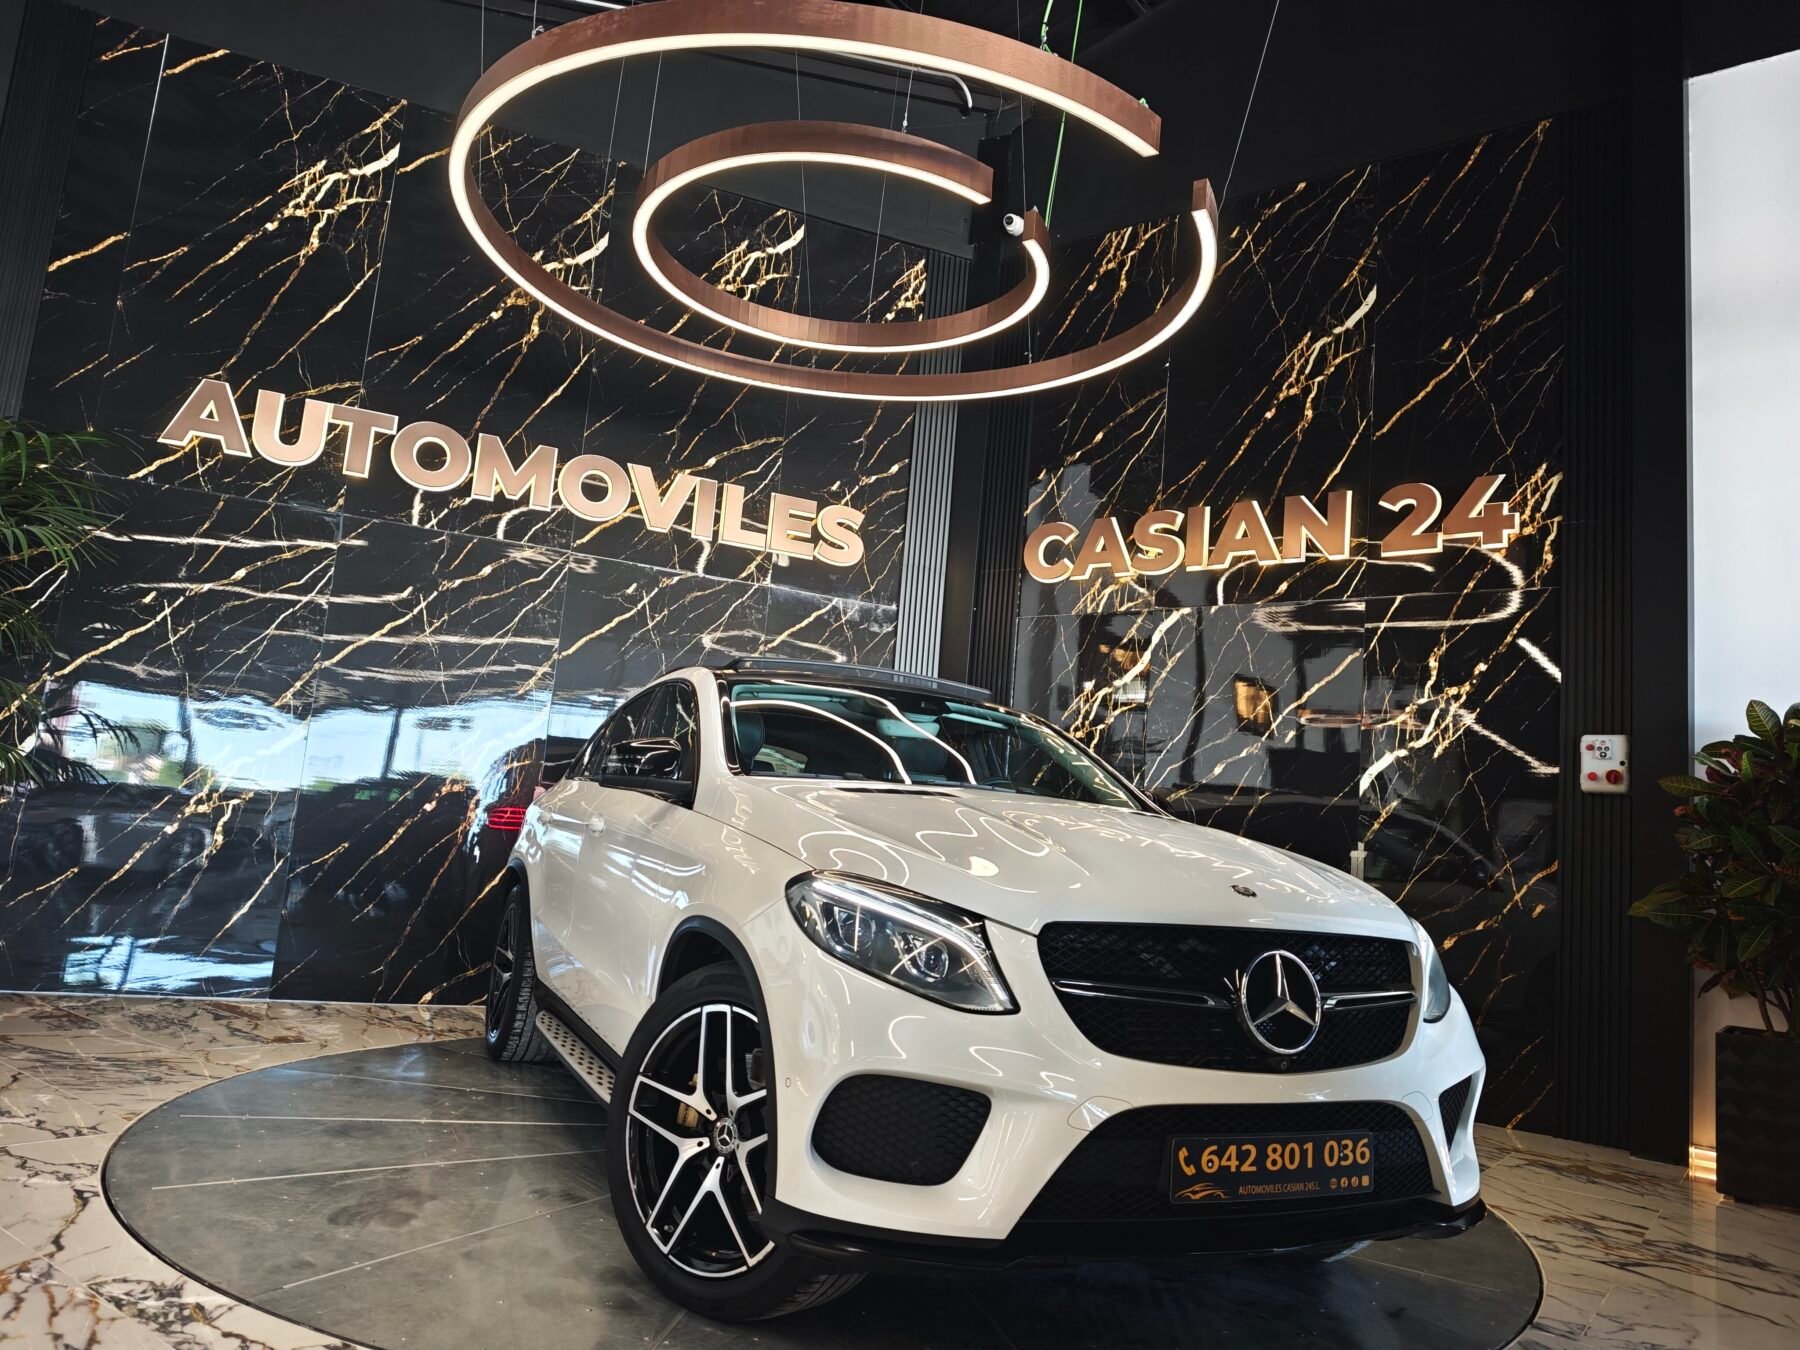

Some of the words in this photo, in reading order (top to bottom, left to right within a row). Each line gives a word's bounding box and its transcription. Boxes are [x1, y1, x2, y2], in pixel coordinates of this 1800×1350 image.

[158, 378, 864, 567] AUTOMOVILES
[1023, 490, 1353, 583] CASIAN
[1378, 474, 1520, 557] 24
[1201, 1145, 1257, 1174] 642
[1266, 1142, 1314, 1171] 801
[1323, 1139, 1371, 1167] 036
[1238, 1183, 1282, 1195] AUTOMOVILES
[1283, 1181, 1304, 1193] CASIAN
